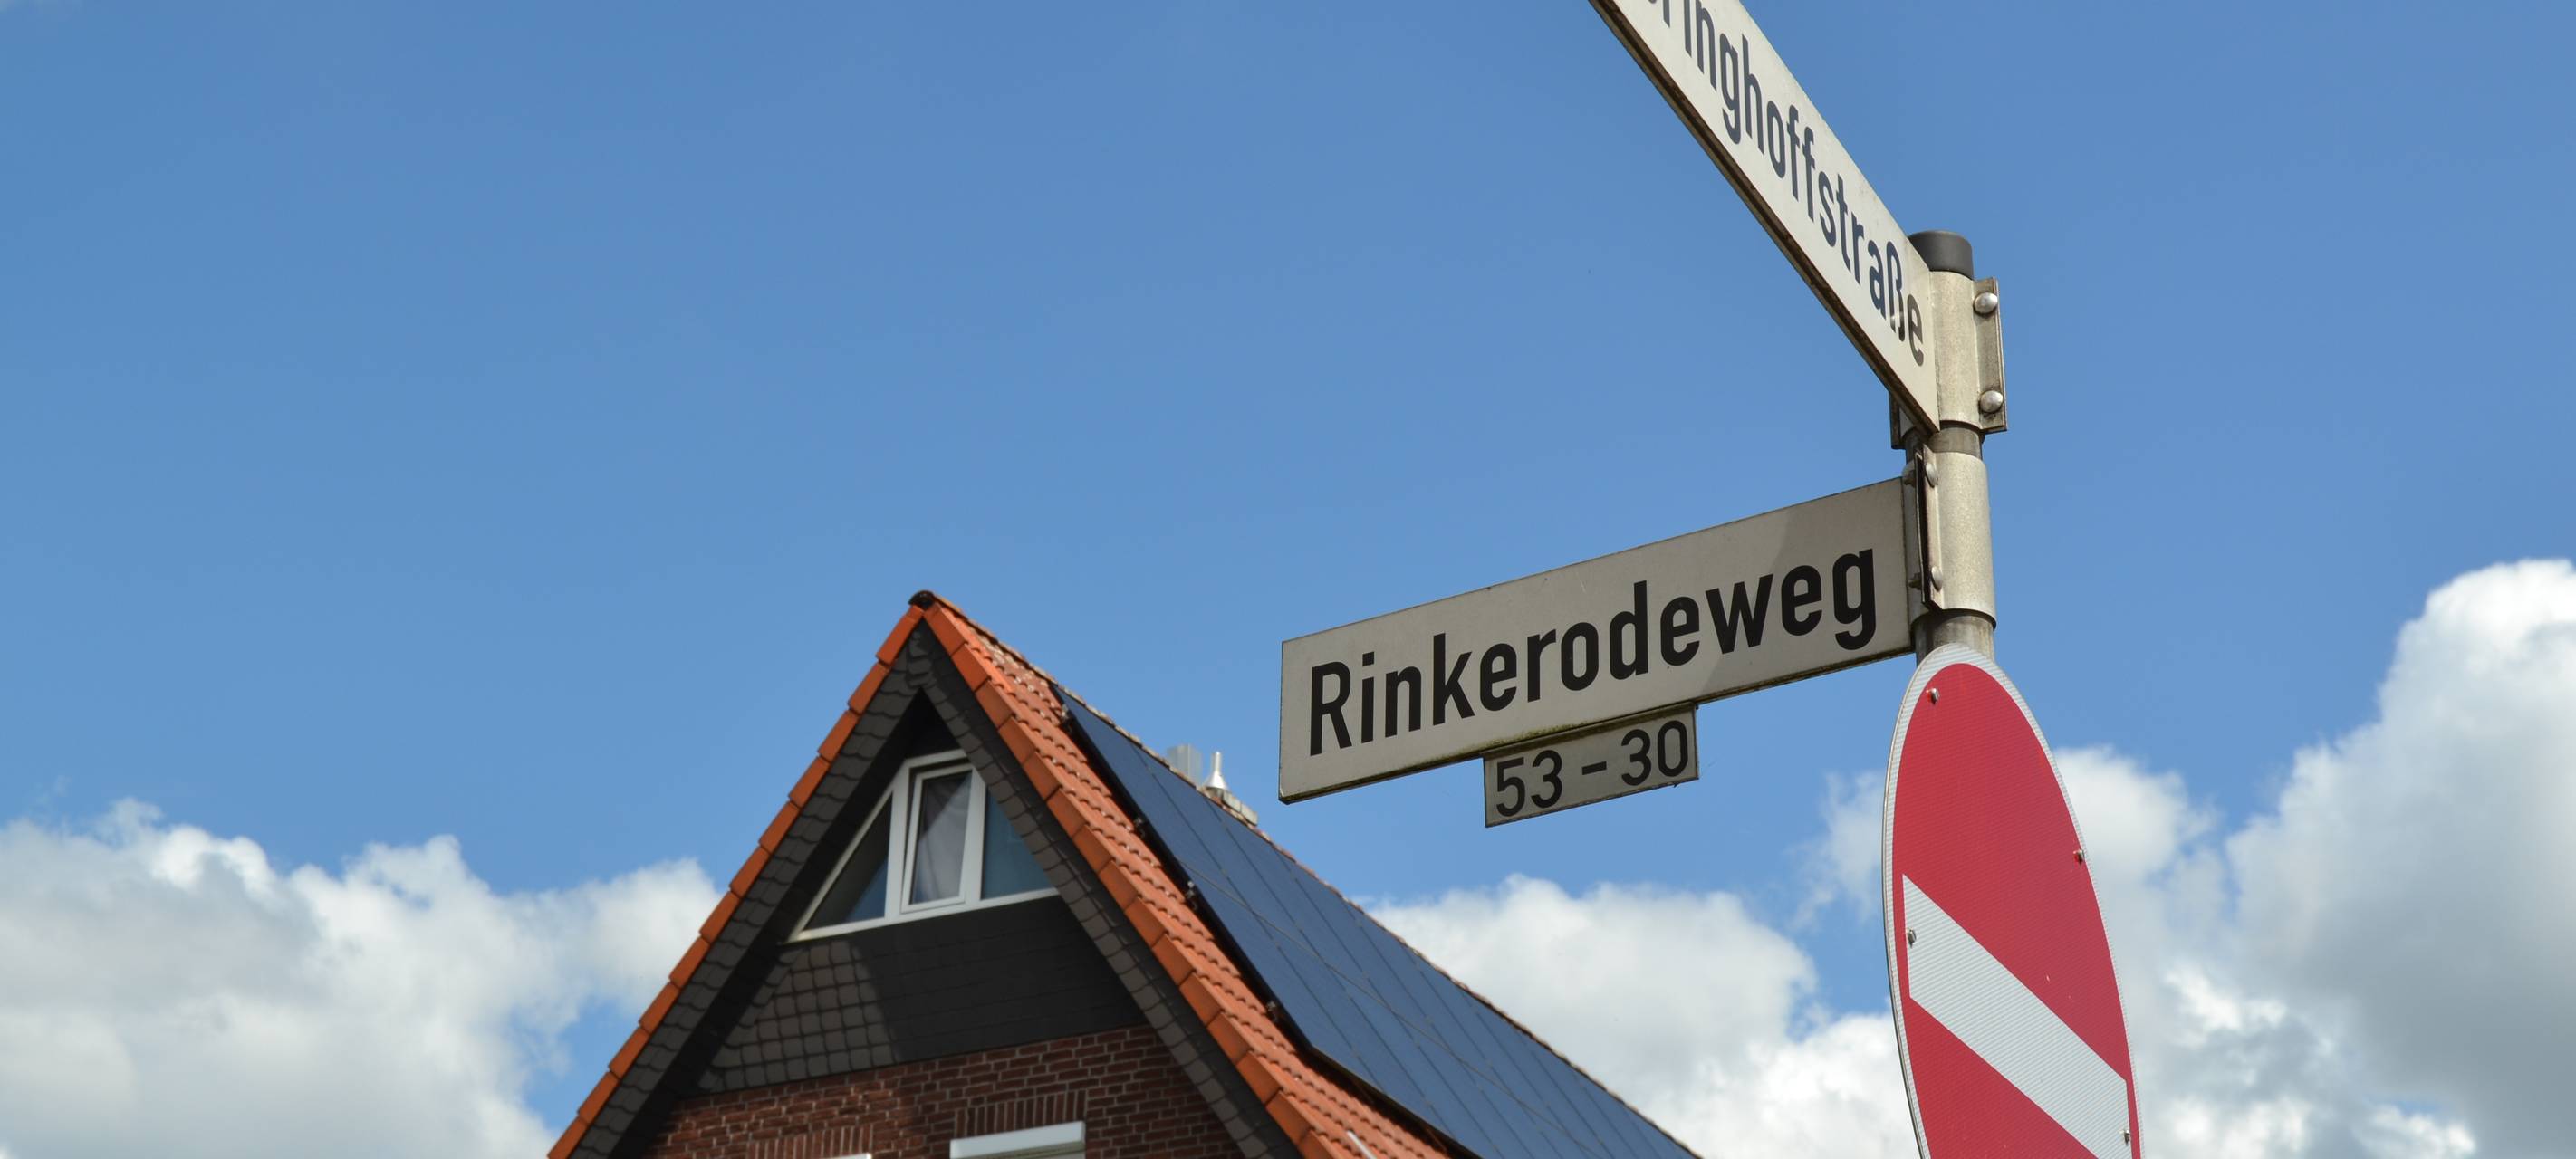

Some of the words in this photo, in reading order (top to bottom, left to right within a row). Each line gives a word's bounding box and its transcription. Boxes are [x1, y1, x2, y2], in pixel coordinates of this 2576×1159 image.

[1648, 0, 1925, 367] inghoffstraße
[1309, 548, 1877, 756] Rinkerodeweg
[1495, 749, 1563, 817] 53
[1620, 720, 1688, 786] 30
